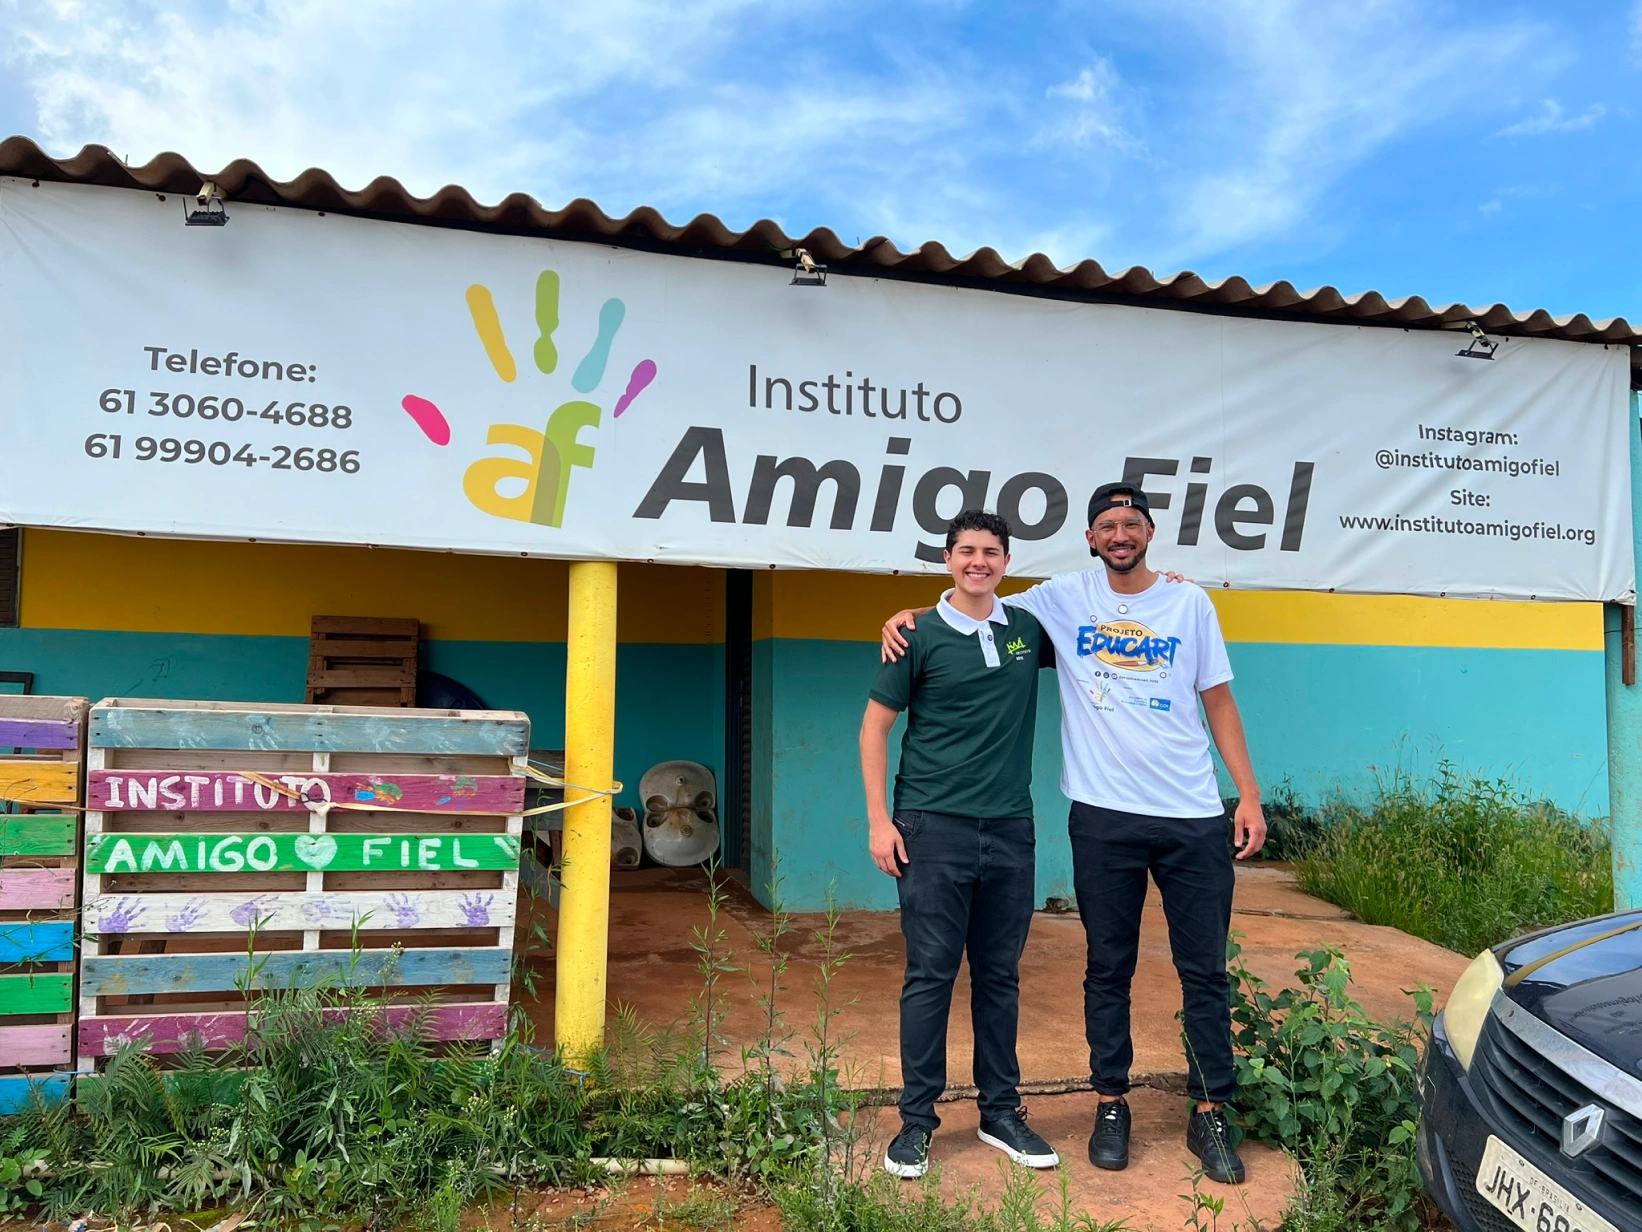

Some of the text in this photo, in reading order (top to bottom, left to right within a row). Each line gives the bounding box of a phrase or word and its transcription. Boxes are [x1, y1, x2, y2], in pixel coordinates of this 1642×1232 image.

[143, 346, 317, 383] Telefone:
[99, 388, 352, 429] 61 3060-4688
[749, 364, 962, 424] Instituto
[84, 433, 361, 474] 61 99904-2686
[1418, 424, 1519, 447] Instagram:
[1375, 448, 1560, 477] @institutoamigofiel
[632, 426, 1069, 564] Amigo
[1450, 488, 1491, 507] Site:
[1339, 513, 1595, 546] www.institutoamigofiel.org
[1077, 626, 1183, 668] EDUCART
[1100, 624, 1143, 637] PROJETO
[105, 775, 332, 812] INSTITUTO
[105, 836, 480, 873] AMIGO FIEL
